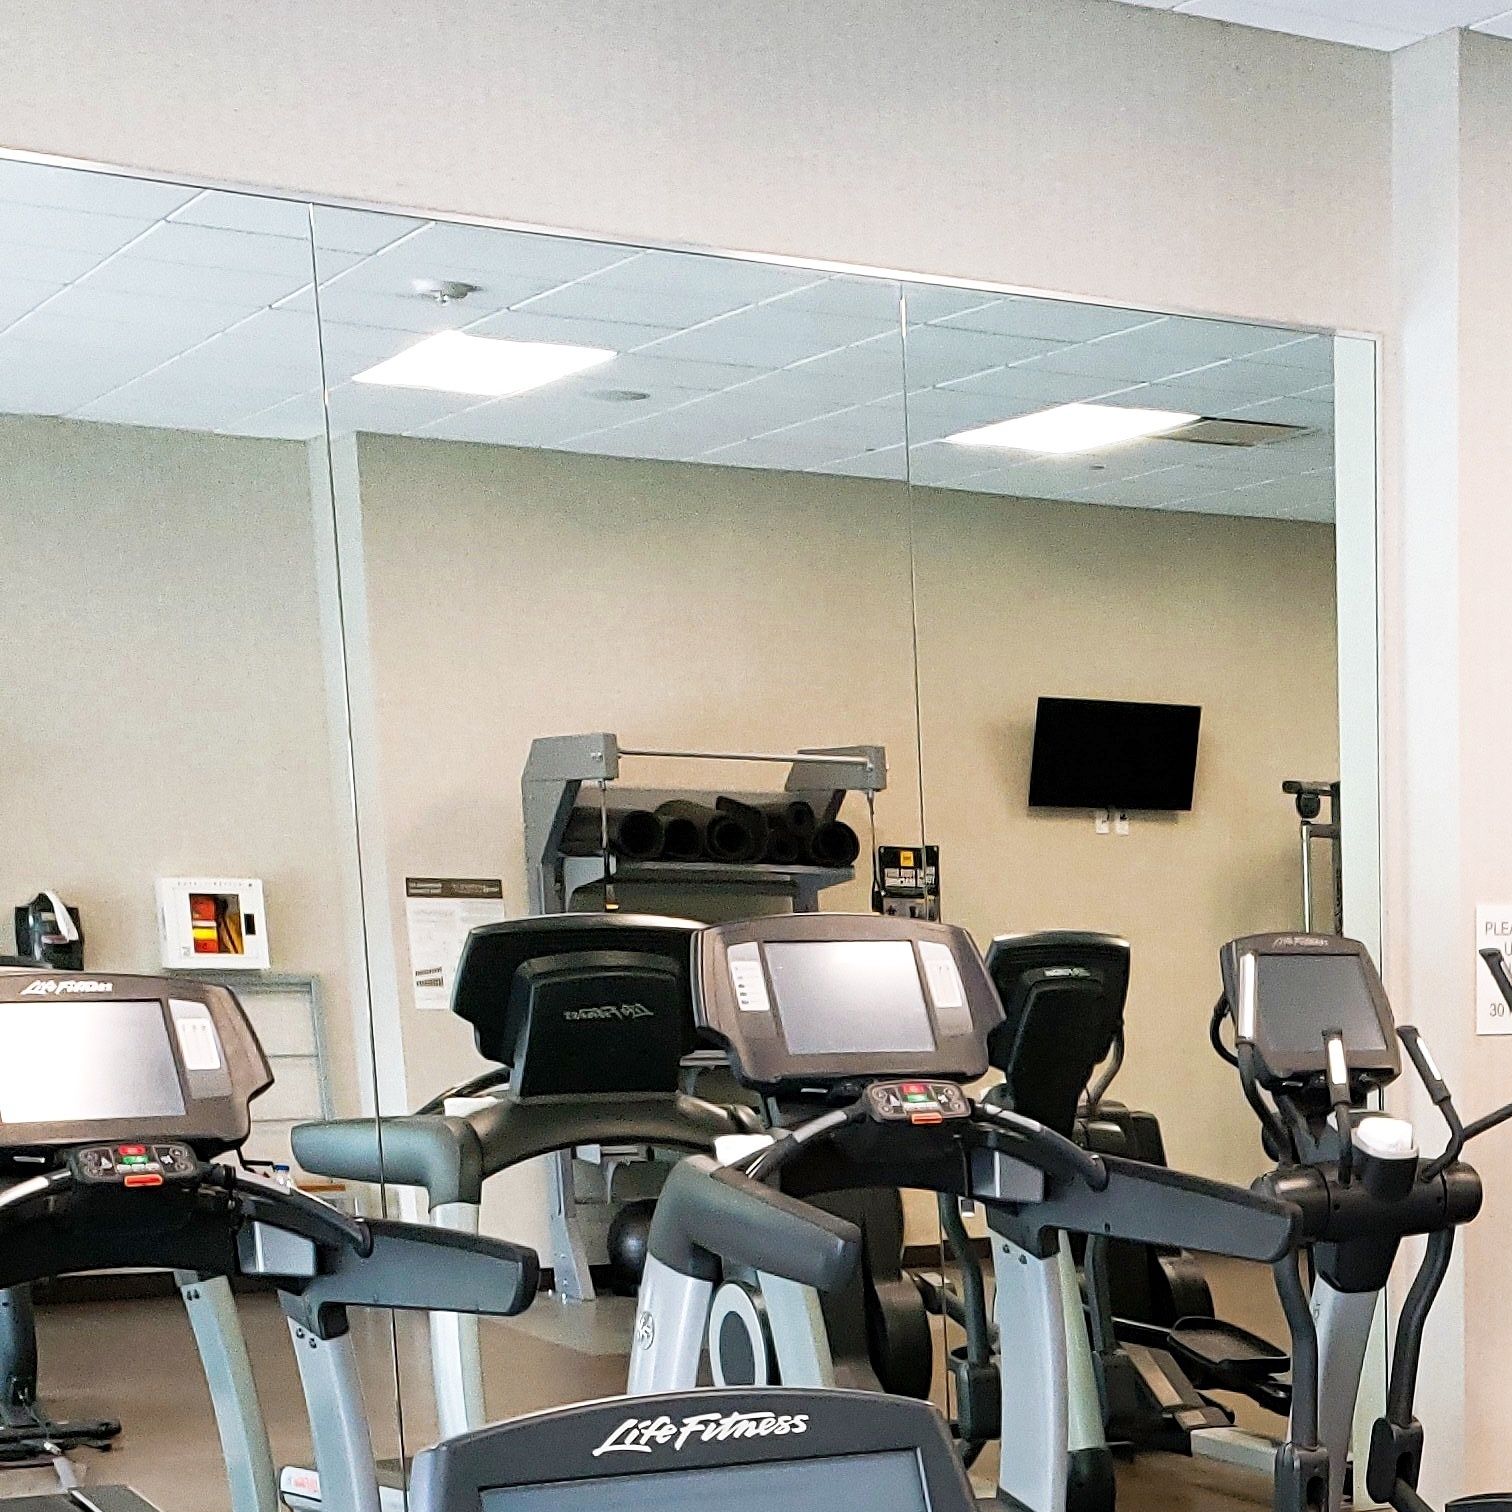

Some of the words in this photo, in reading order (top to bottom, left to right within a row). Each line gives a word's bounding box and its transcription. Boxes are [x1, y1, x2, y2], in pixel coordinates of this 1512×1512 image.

[1489, 1003, 1505, 1018] 30
[592, 1418, 678, 1457] Life
[674, 1411, 809, 1451] Fitness
